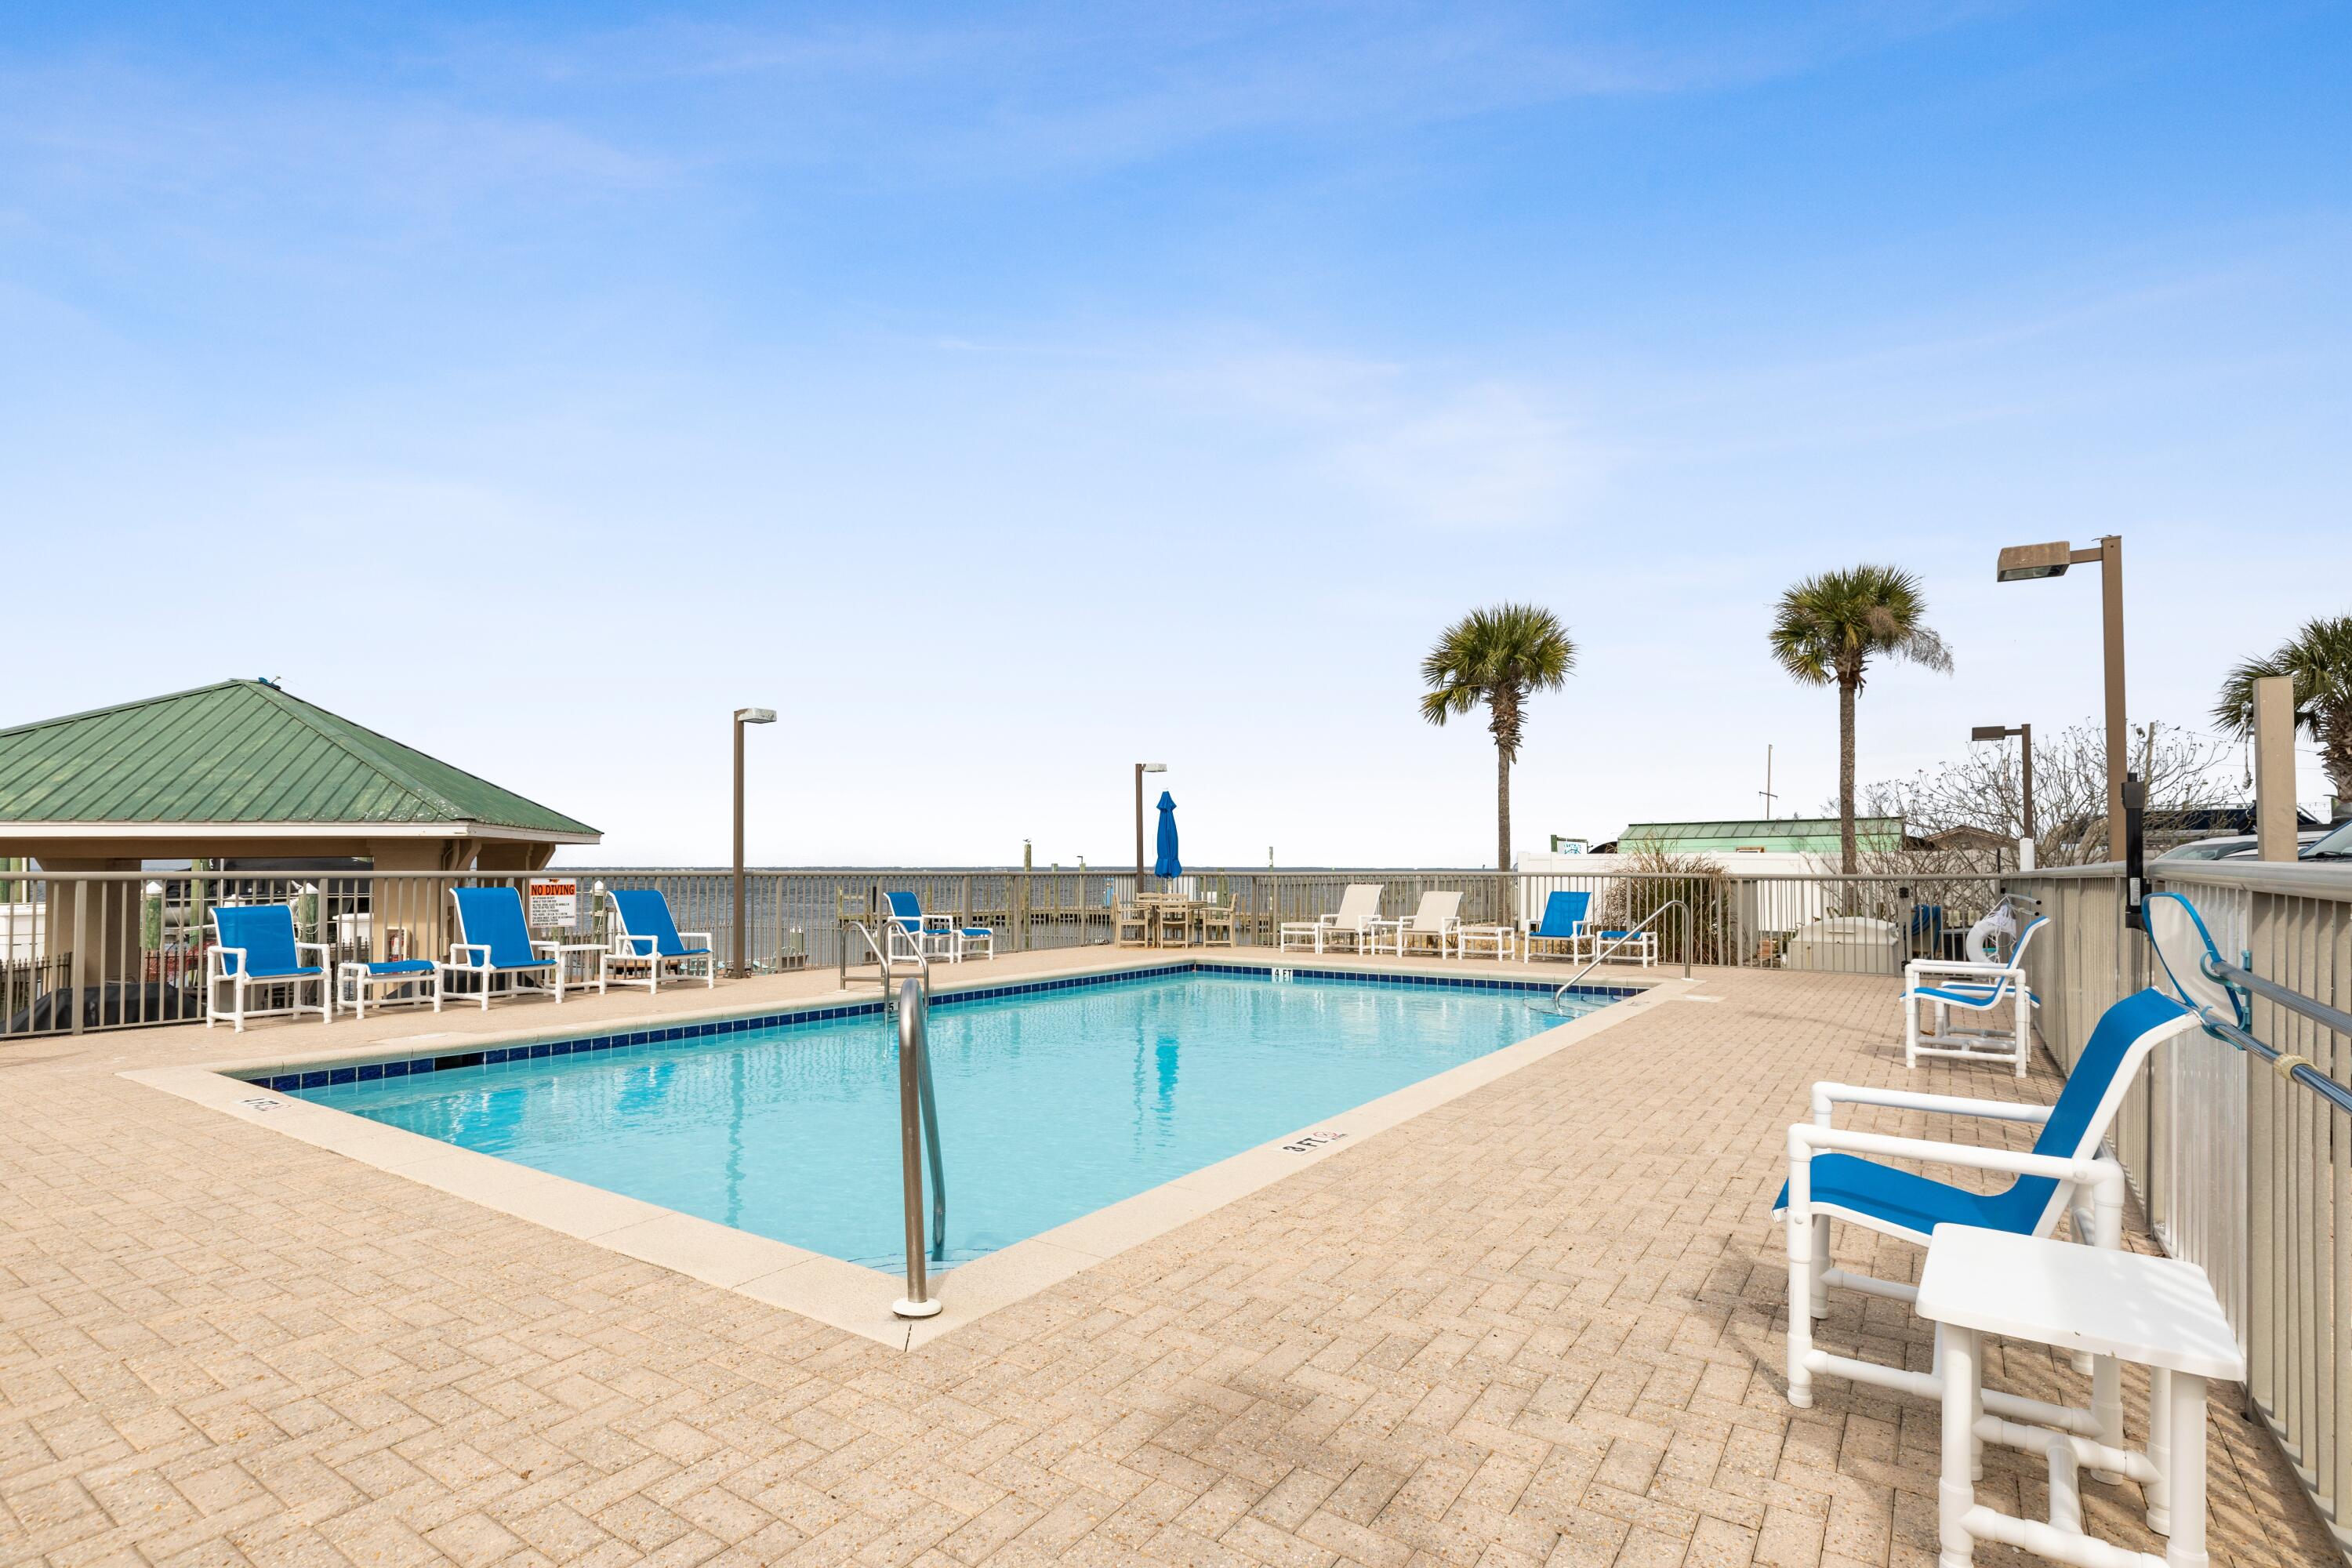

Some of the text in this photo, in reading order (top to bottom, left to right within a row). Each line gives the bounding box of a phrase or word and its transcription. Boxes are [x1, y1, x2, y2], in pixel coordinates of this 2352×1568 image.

[532, 884, 575, 895] NO DIVING
[888, 1002, 895, 1011] 5
[1296, 1138, 1329, 1147] FT
